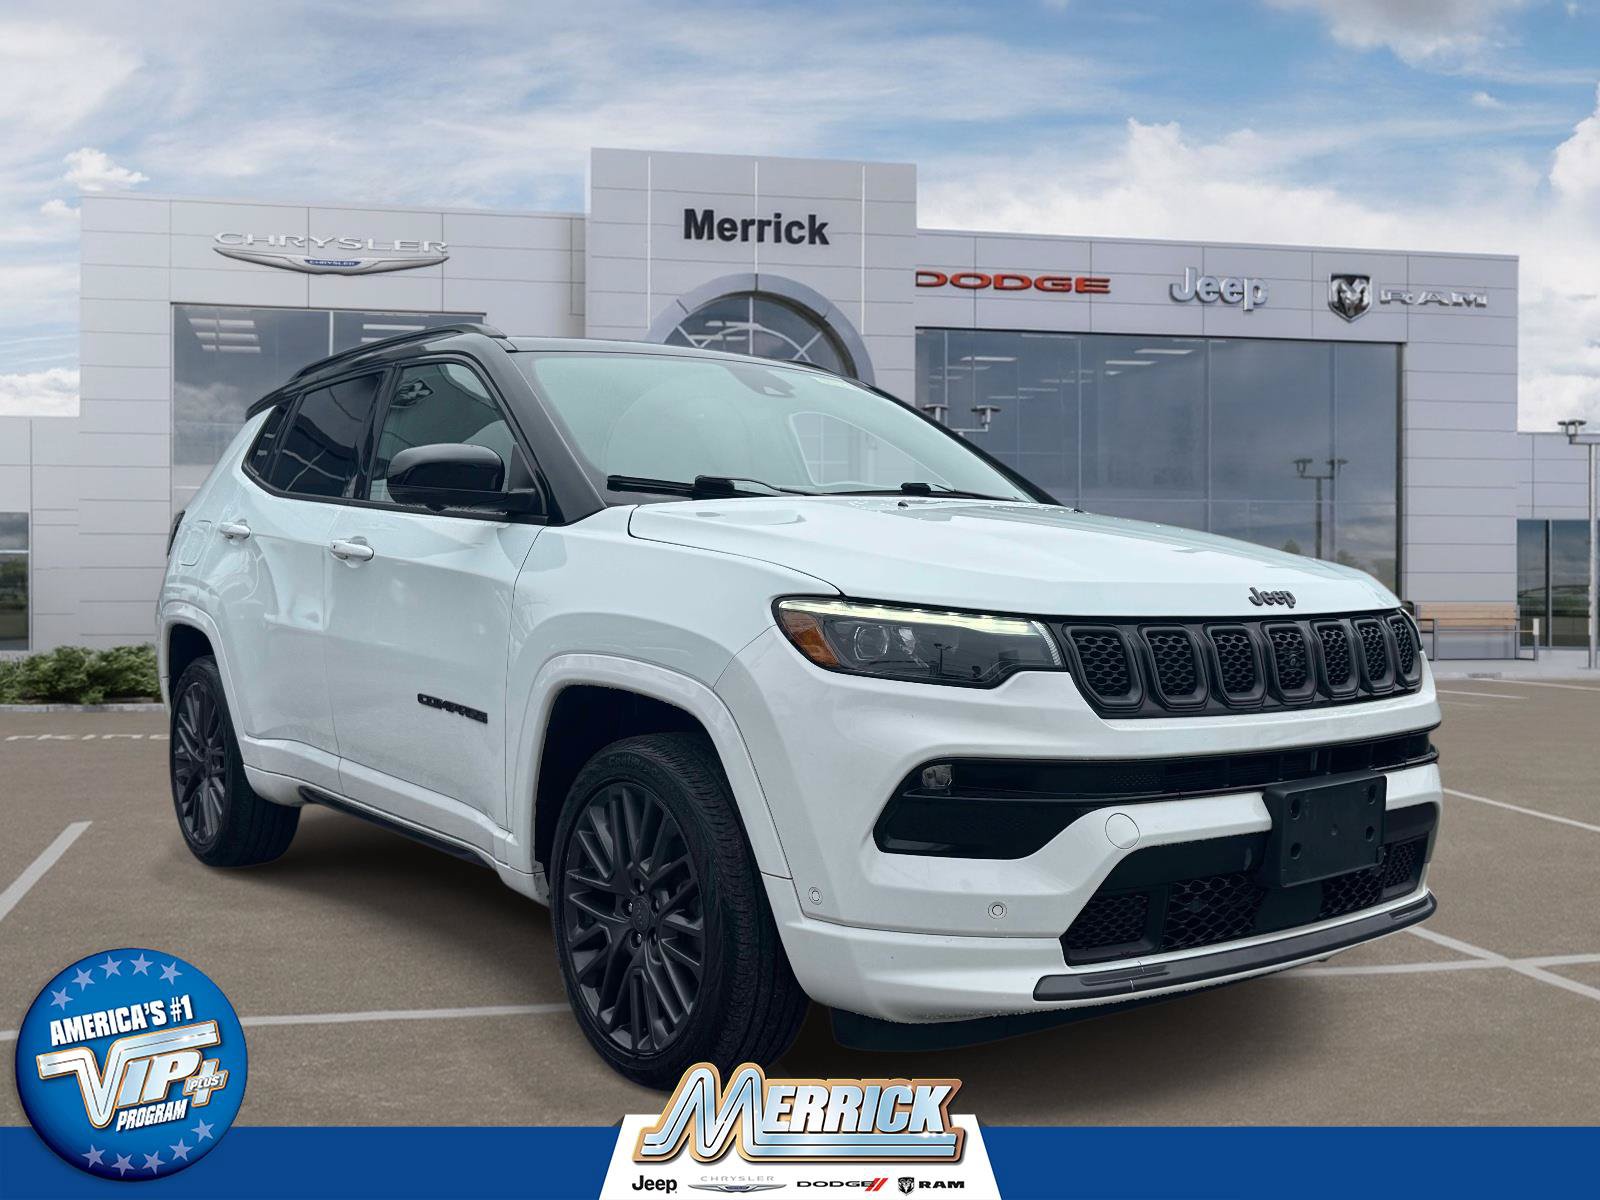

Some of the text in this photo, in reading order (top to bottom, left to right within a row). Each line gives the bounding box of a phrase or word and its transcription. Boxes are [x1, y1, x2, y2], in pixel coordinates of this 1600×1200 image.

[683, 208, 830, 246] Merrick
[213, 231, 450, 254] CHRYSLER
[915, 271, 1111, 294] DODGE
[1170, 267, 1268, 311] Jeep
[1379, 289, 1488, 308] RAM
[1248, 586, 1297, 609] Jeep
